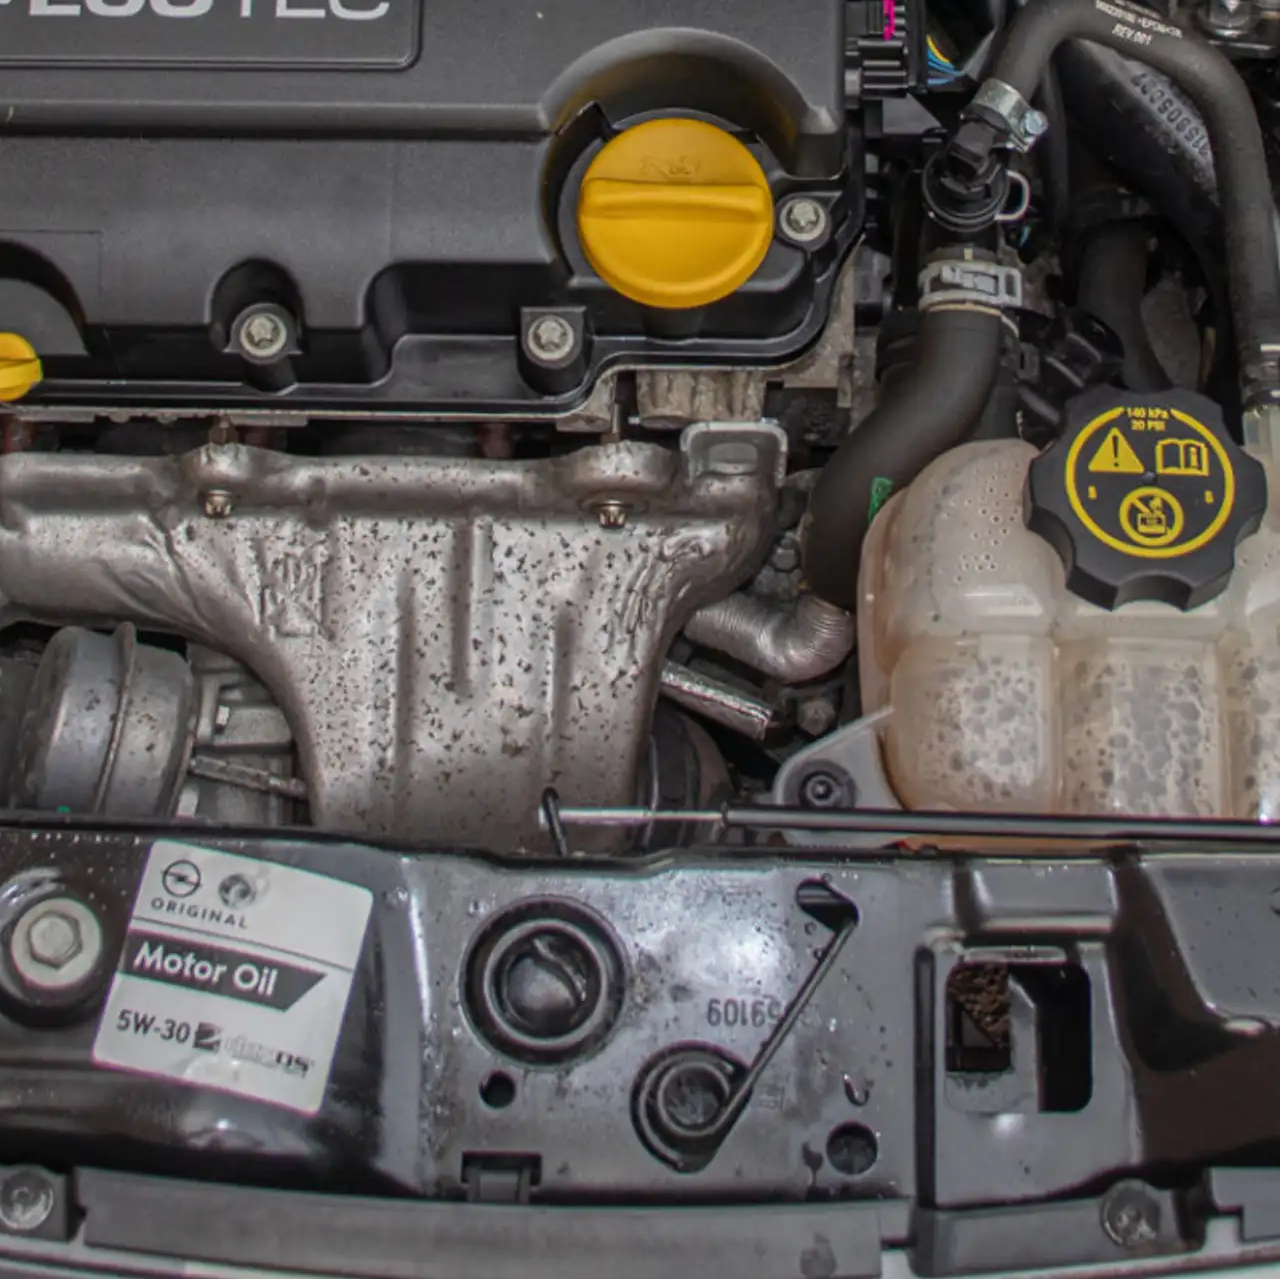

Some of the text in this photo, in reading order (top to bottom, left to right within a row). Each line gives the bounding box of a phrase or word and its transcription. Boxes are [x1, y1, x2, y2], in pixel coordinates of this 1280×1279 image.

[151, 897, 248, 929] ORIGINAL
[133, 942, 278, 996] Motor Oil
[116, 1009, 191, 1044] 5W-30
